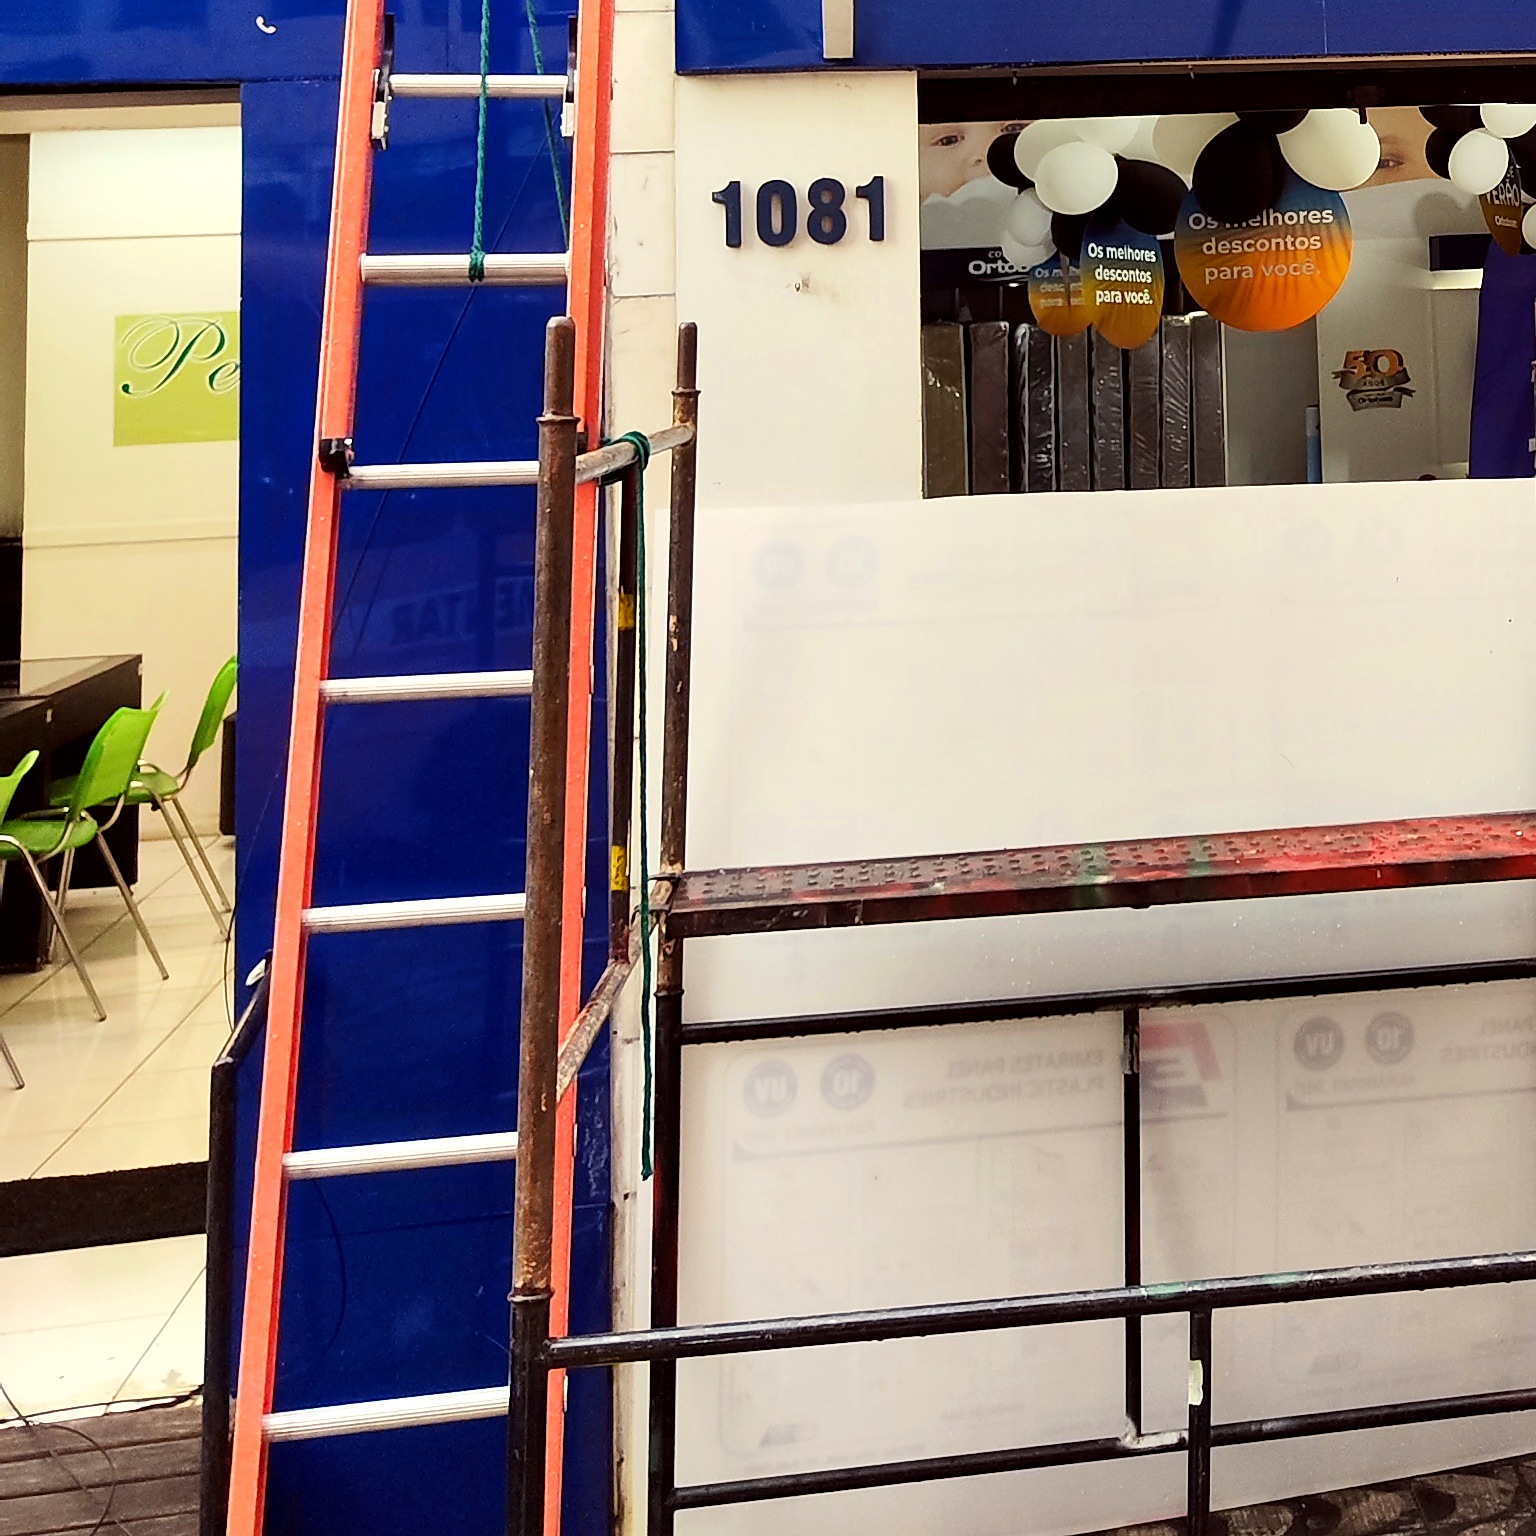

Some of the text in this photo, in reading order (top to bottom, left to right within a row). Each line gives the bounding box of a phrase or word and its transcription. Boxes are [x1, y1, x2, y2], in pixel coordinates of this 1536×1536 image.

[711, 175, 885, 248] 1081
[1188, 208, 1334, 231] Os elhores
[1088, 242, 1156, 263] Os melhores
[1202, 234, 1322, 255] descontos
[1095, 264, 1152, 283] descontos
[1204, 258, 1321, 285] para você.
[1095, 289, 1122, 306] para
[1124, 287, 1154, 305] você.
